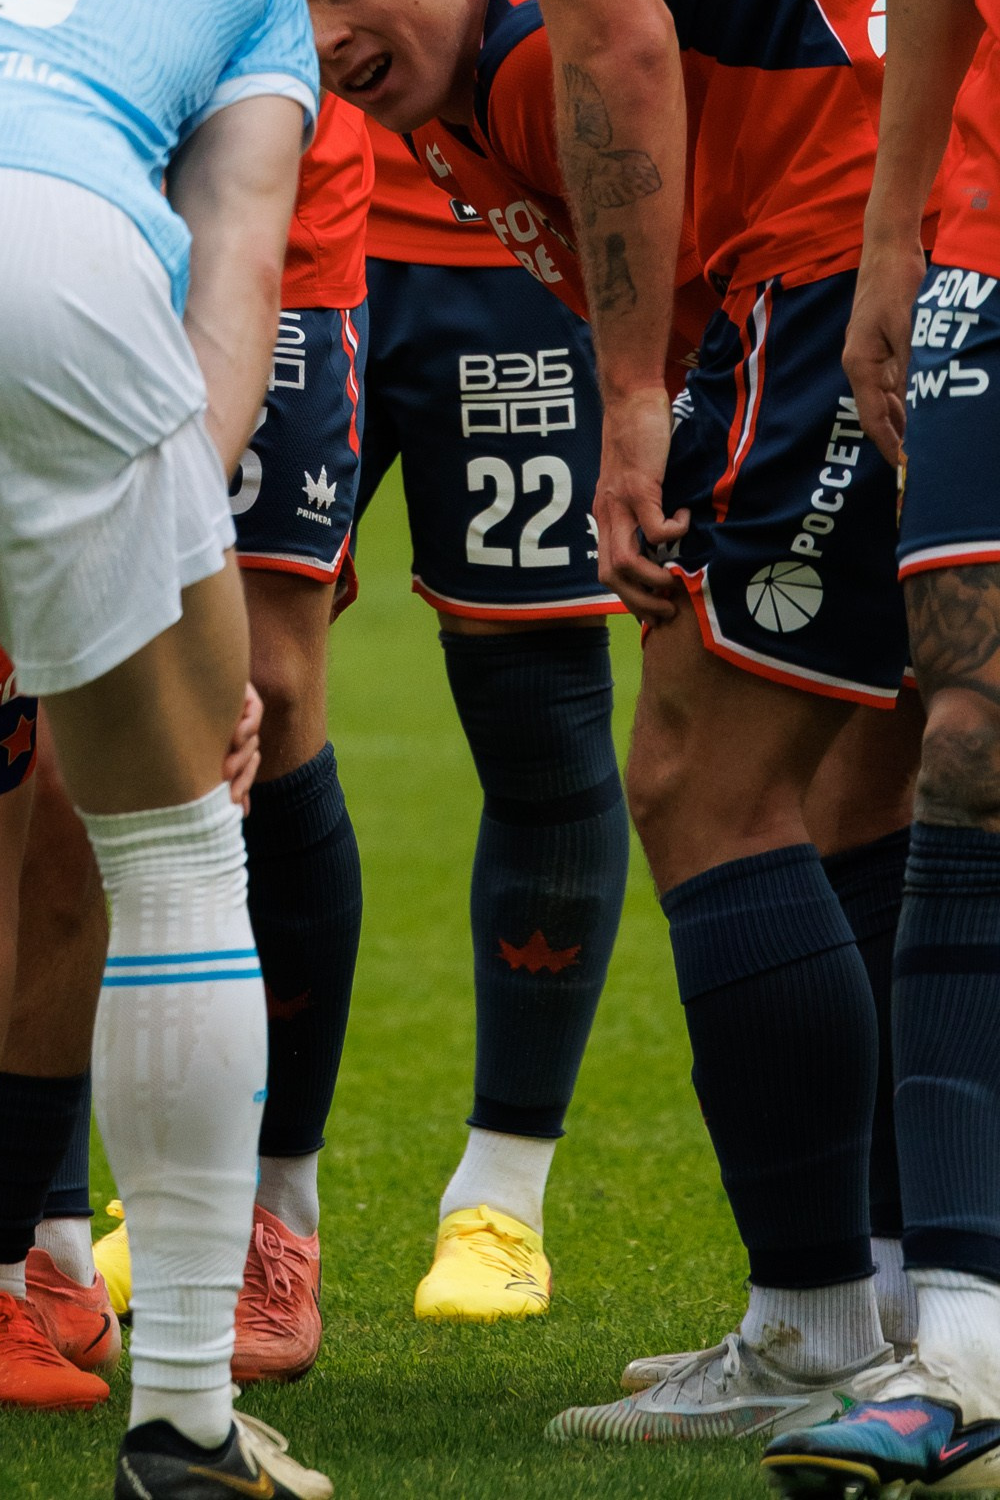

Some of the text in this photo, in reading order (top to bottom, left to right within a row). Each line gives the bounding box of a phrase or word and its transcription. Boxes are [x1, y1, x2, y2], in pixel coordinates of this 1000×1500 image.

[917, 269, 998, 310] FON
[911, 308, 980, 349] BET
[459, 349, 574, 391] ВЭБ
[461, 398, 576, 438] РФ
[790, 396, 865, 558] РОССЕТИ
[296, 507, 332, 527] PRIMERA
[466, 455, 573, 568] 22
